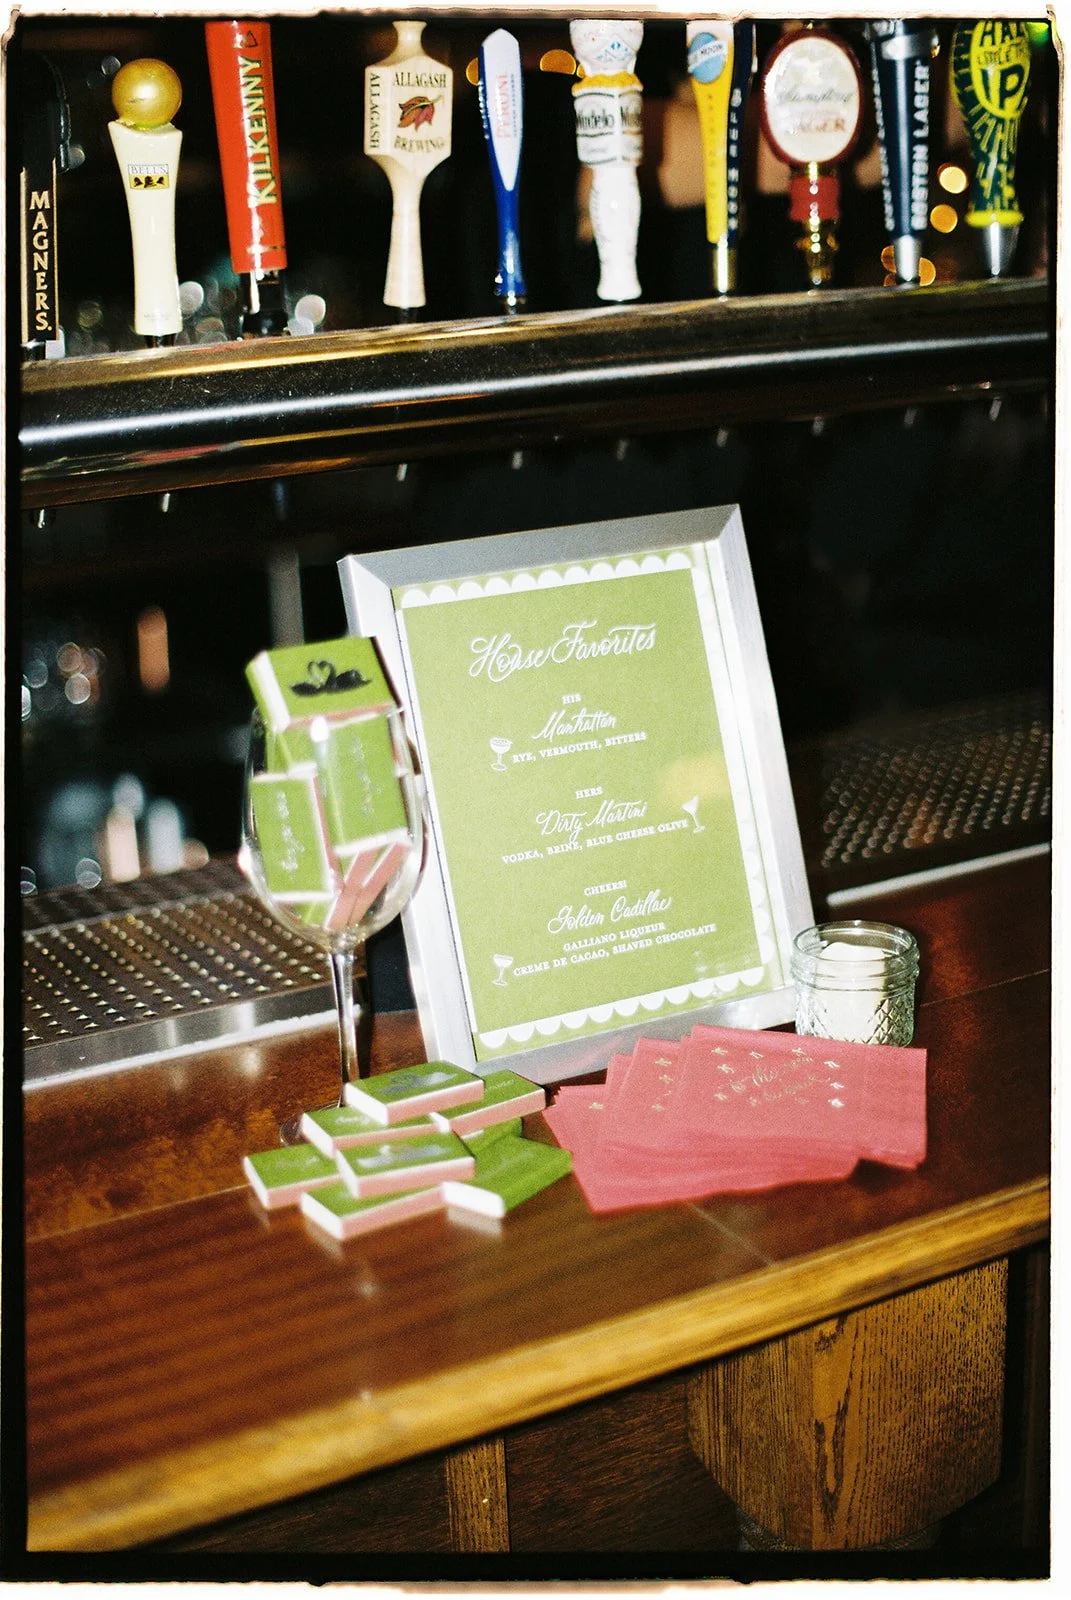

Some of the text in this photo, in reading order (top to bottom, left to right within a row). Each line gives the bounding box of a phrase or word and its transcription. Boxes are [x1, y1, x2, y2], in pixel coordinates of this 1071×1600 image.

[393, 71, 447, 88] ALLAGASH
[369, 72, 381, 148] ALLAGASH
[238, 55, 278, 208] KILKENNY
[394, 135, 446, 153] BREWING
[911, 65, 930, 231] BOSTON LAGER
[29, 190, 53, 331] MAGNERS.
[469, 620, 656, 683] House Favorites
[562, 693, 582, 705] HIS
[532, 708, 617, 742] Manhattan
[511, 731, 648, 764] RYE, VERMOUTH, BITTERS
[575, 786, 603, 800] HERS
[502, 818, 689, 864] VODKA, BRINE, BLUE CHEESE OLIVE
[536, 800, 648, 842] Dirty Martini
[584, 880, 627, 897] CHEERS!
[547, 888, 672, 934] Golden Cadillac
[513, 923, 717, 977] CREME DE CACAO, SHAVED CHOCOLATE
[563, 922, 666, 952] GALLIANO LIQUEUR
